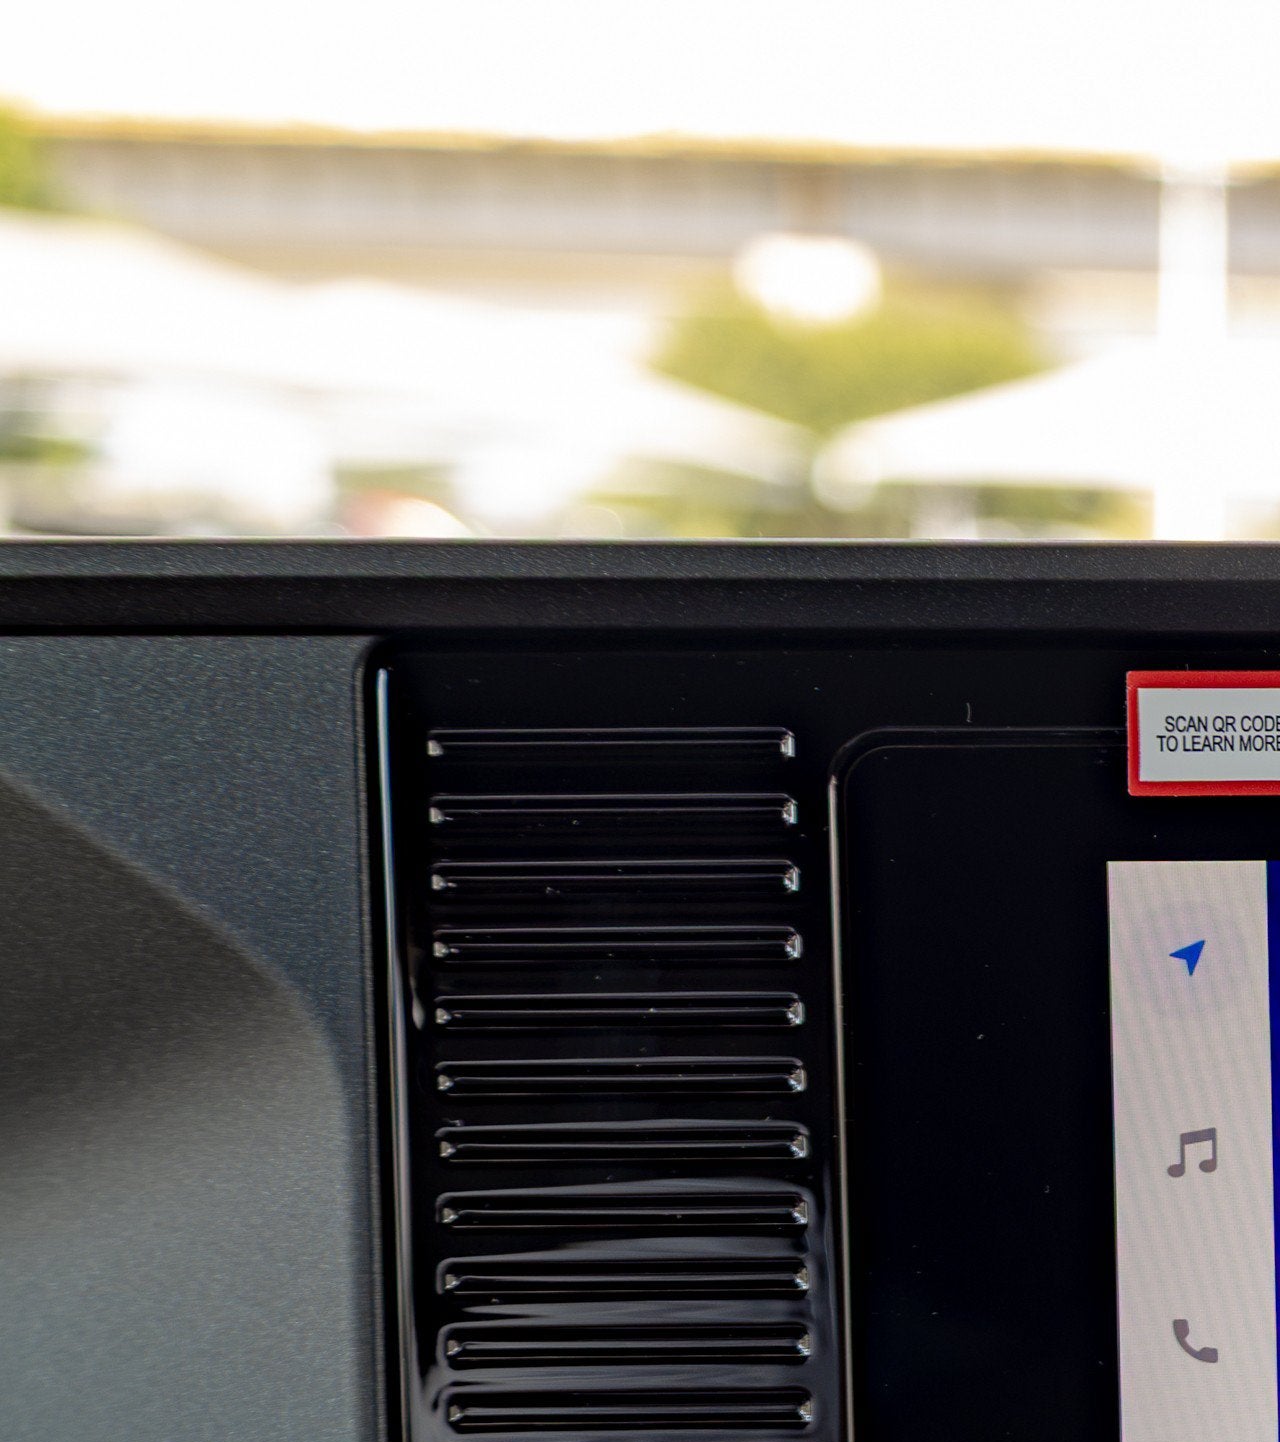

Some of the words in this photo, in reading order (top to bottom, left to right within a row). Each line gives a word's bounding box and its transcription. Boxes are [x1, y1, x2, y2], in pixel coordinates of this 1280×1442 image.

[1164, 715, 1208, 733] SCAN
[1212, 715, 1237, 733] QR
[1155, 734, 1179, 753] TO
[1182, 734, 1235, 753] LEARN
